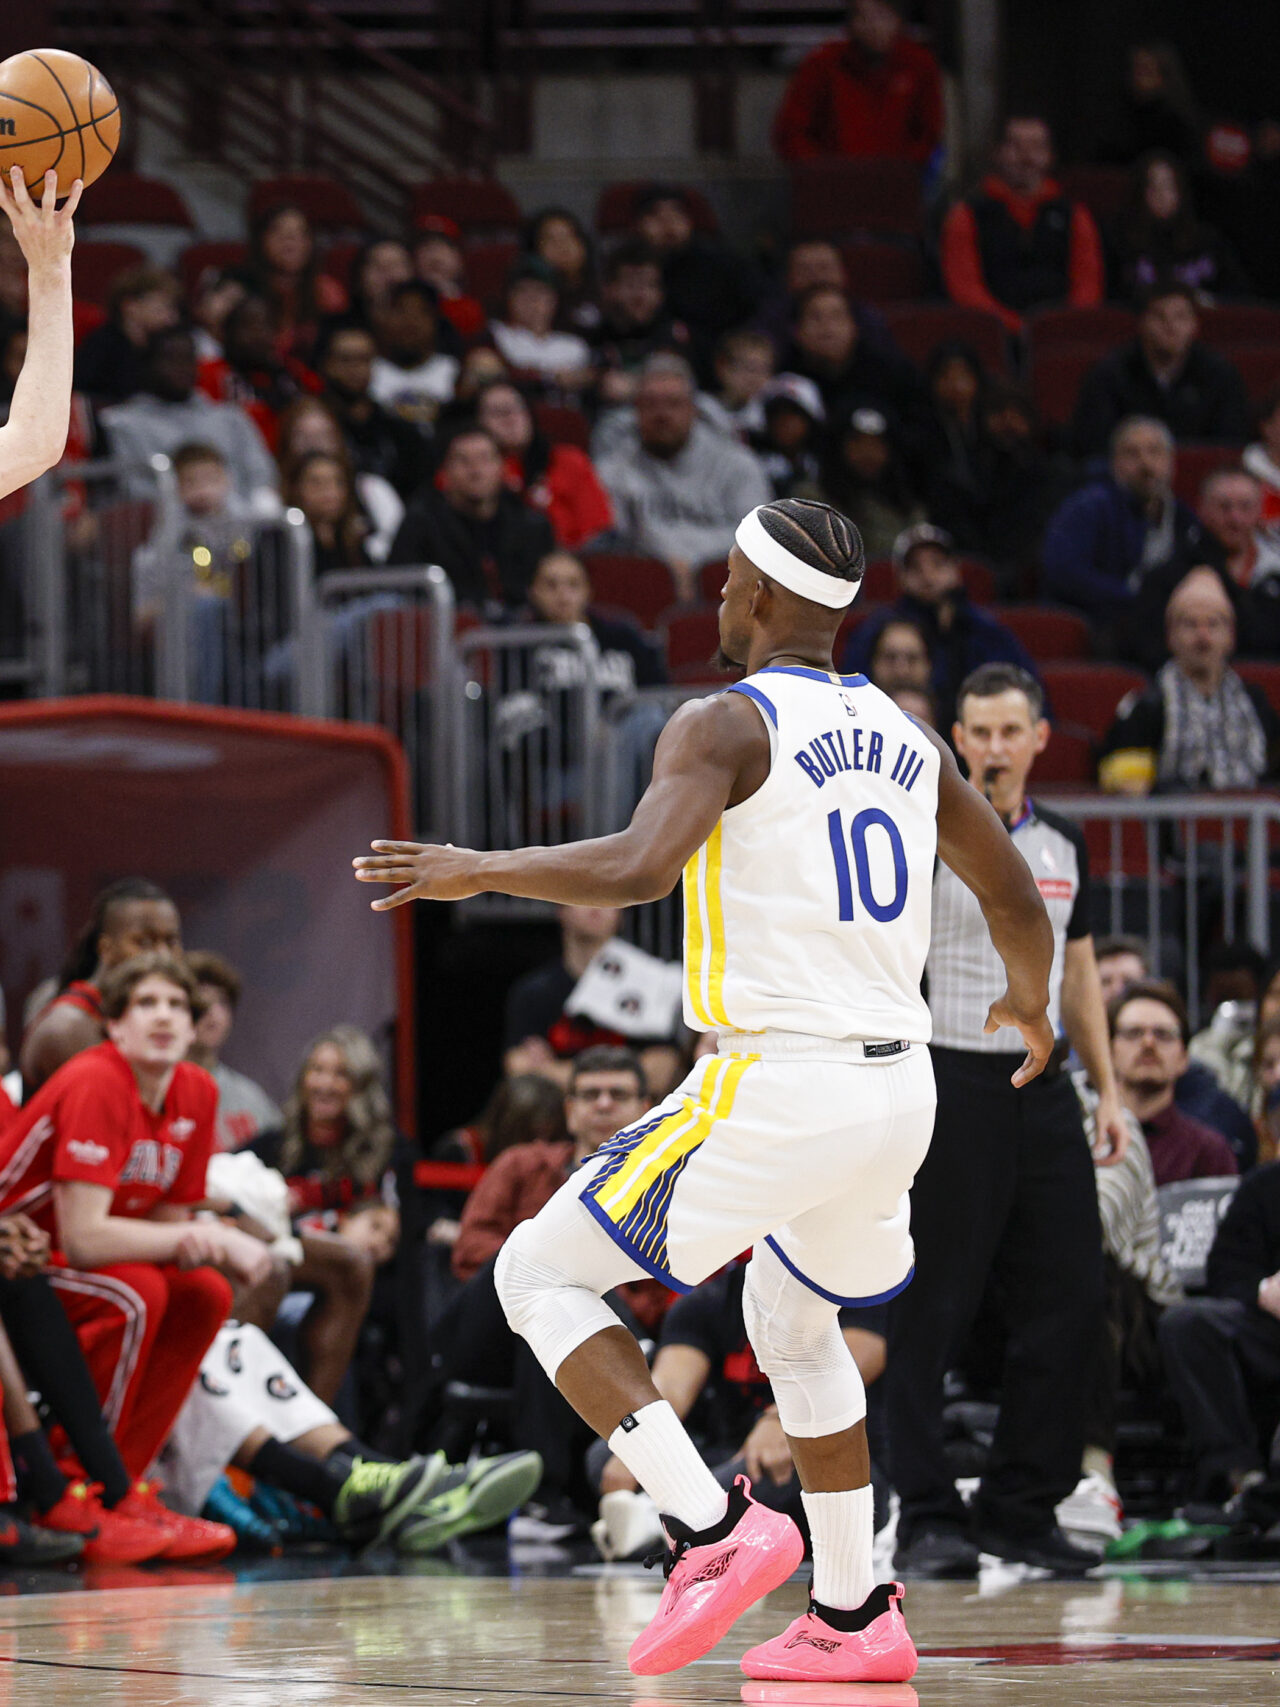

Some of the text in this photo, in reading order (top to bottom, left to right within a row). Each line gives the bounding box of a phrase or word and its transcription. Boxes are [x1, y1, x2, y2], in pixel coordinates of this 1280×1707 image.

[794, 728, 925, 793] BUTLER III
[827, 807, 909, 923] 10
